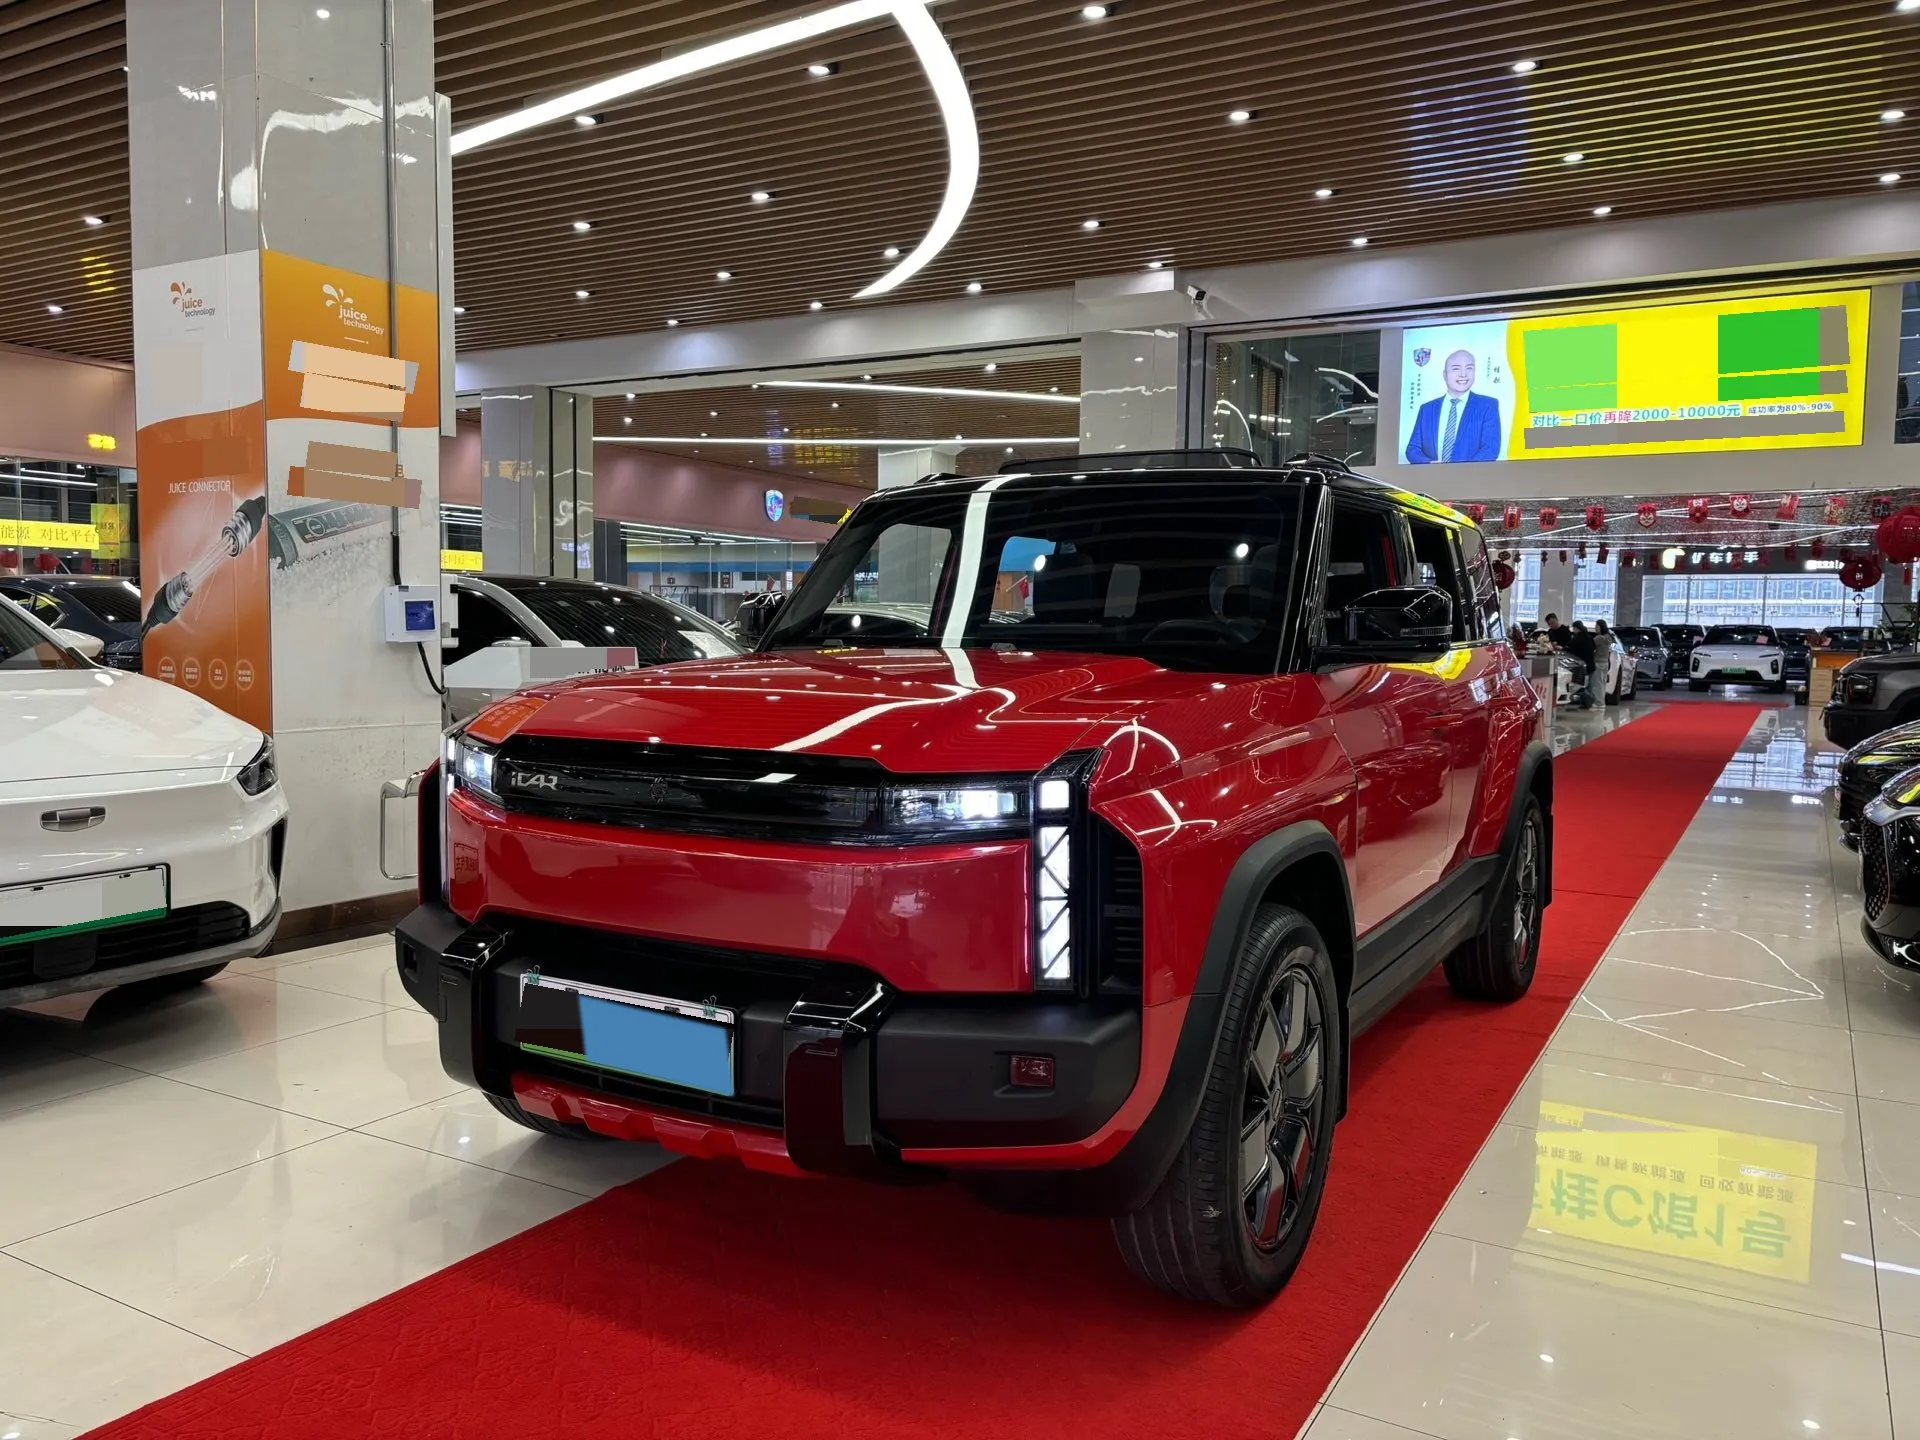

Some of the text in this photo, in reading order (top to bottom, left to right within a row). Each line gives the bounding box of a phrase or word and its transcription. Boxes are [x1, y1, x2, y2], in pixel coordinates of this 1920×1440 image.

[181, 293, 203, 312] juice
[185, 306, 216, 318] technology
[338, 304, 368, 321] juice
[343, 317, 385, 335] technology
[1532, 403, 1742, 427] 对比一口价再降2000-10000元
[167, 479, 231, 494] JUICE CONNECTOR
[0, 524, 96, 543] 能源 对比平台
